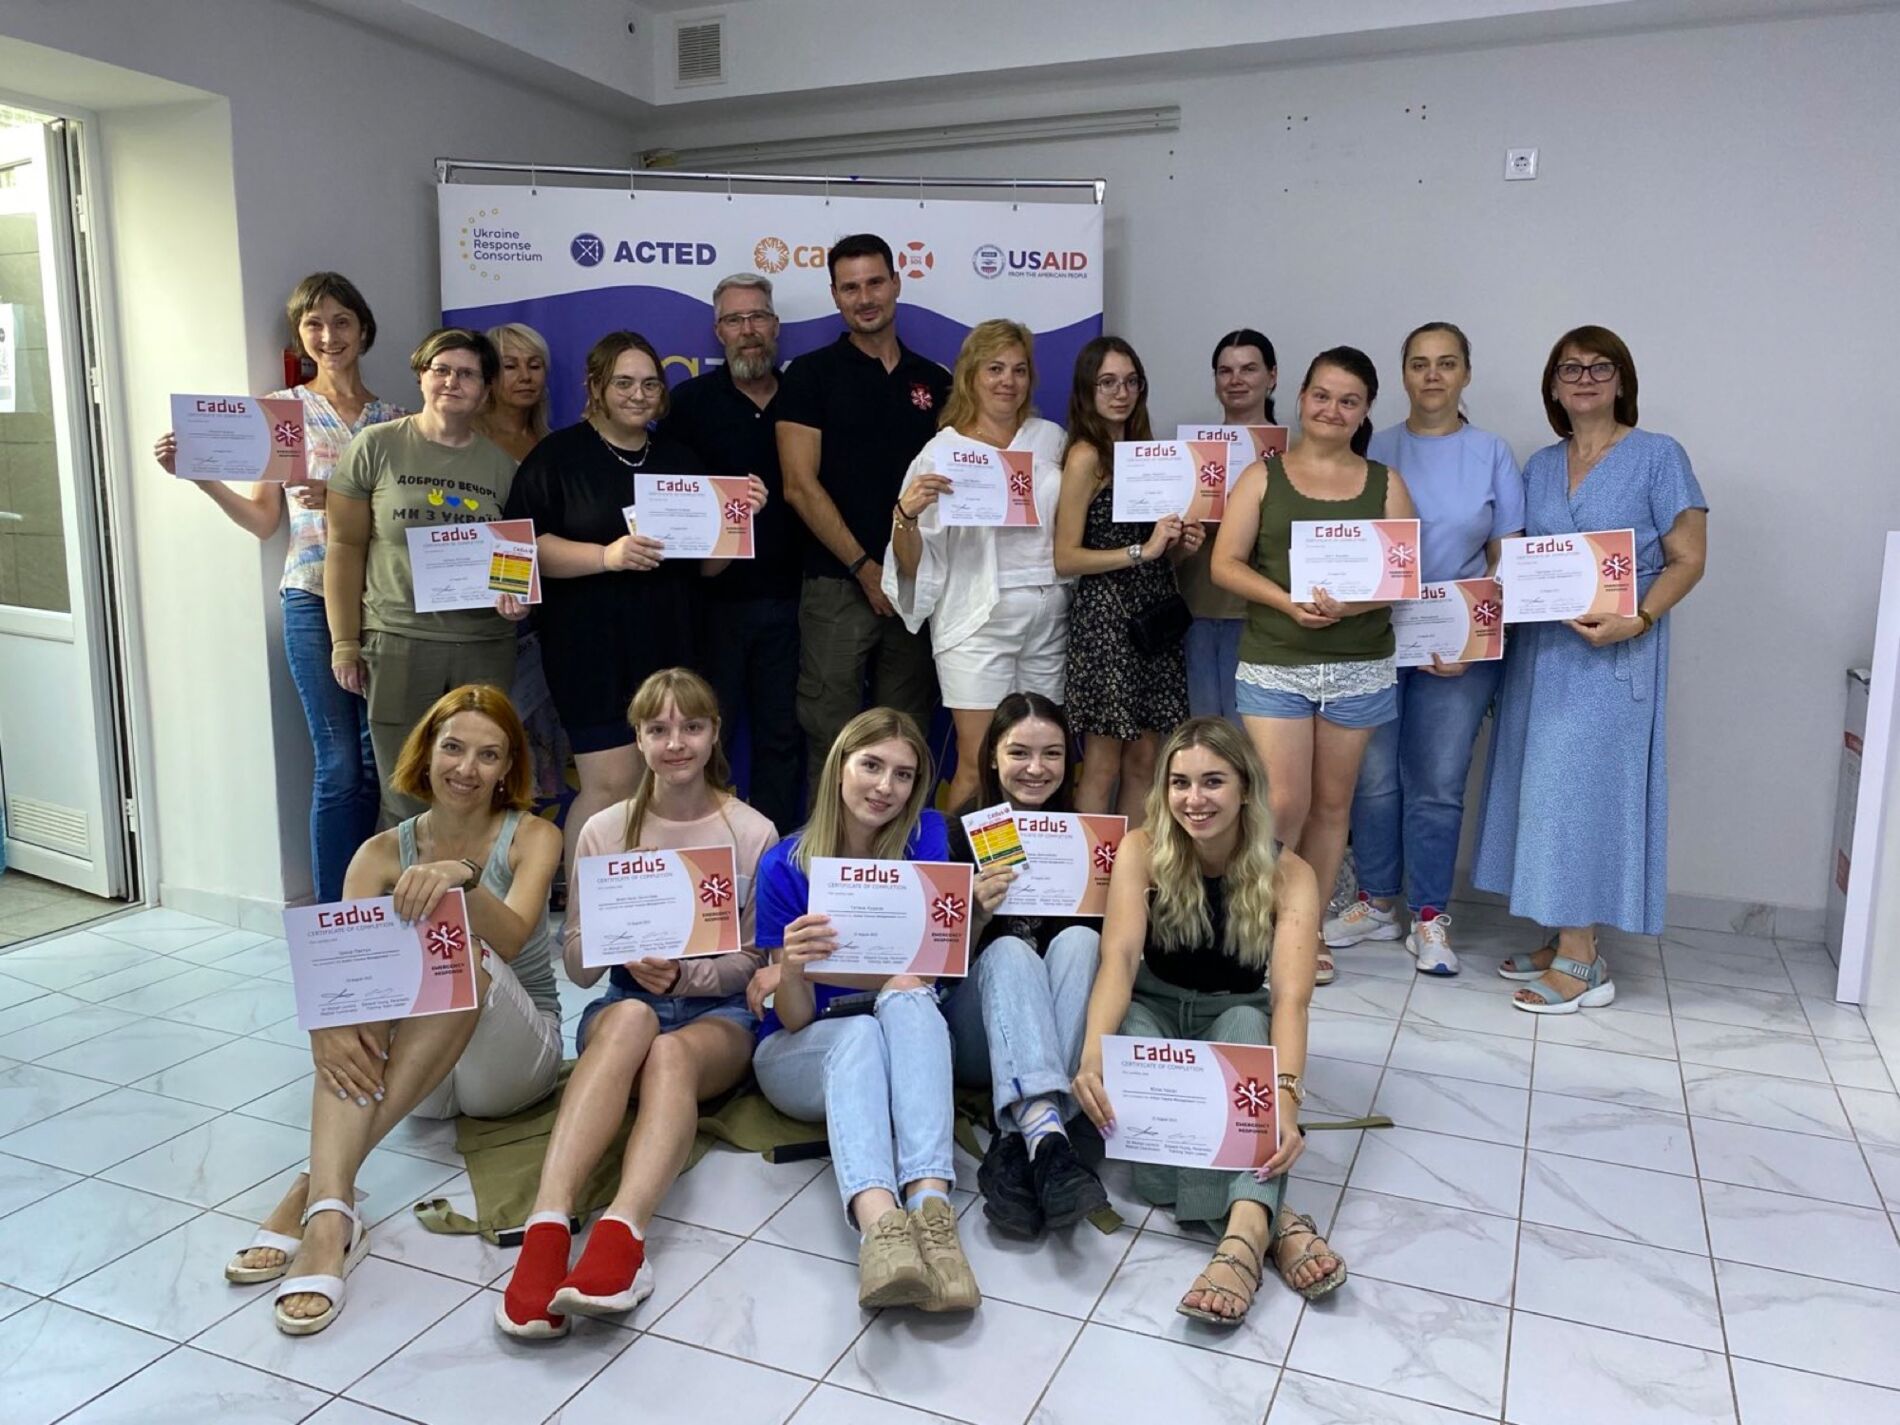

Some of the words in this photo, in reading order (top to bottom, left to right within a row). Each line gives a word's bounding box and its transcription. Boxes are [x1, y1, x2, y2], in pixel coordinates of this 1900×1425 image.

[473, 228, 520, 239] Ukraine
[473, 239, 531, 251] Response
[473, 250, 543, 262] Consortium
[613, 240, 717, 266] ACTED
[793, 246, 831, 268] ca
[1008, 250, 1088, 270] USAID
[397, 475, 455, 489] ДОБРОГО
[392, 508, 419, 520] МИ
[1421, 586, 1446, 599] dus
